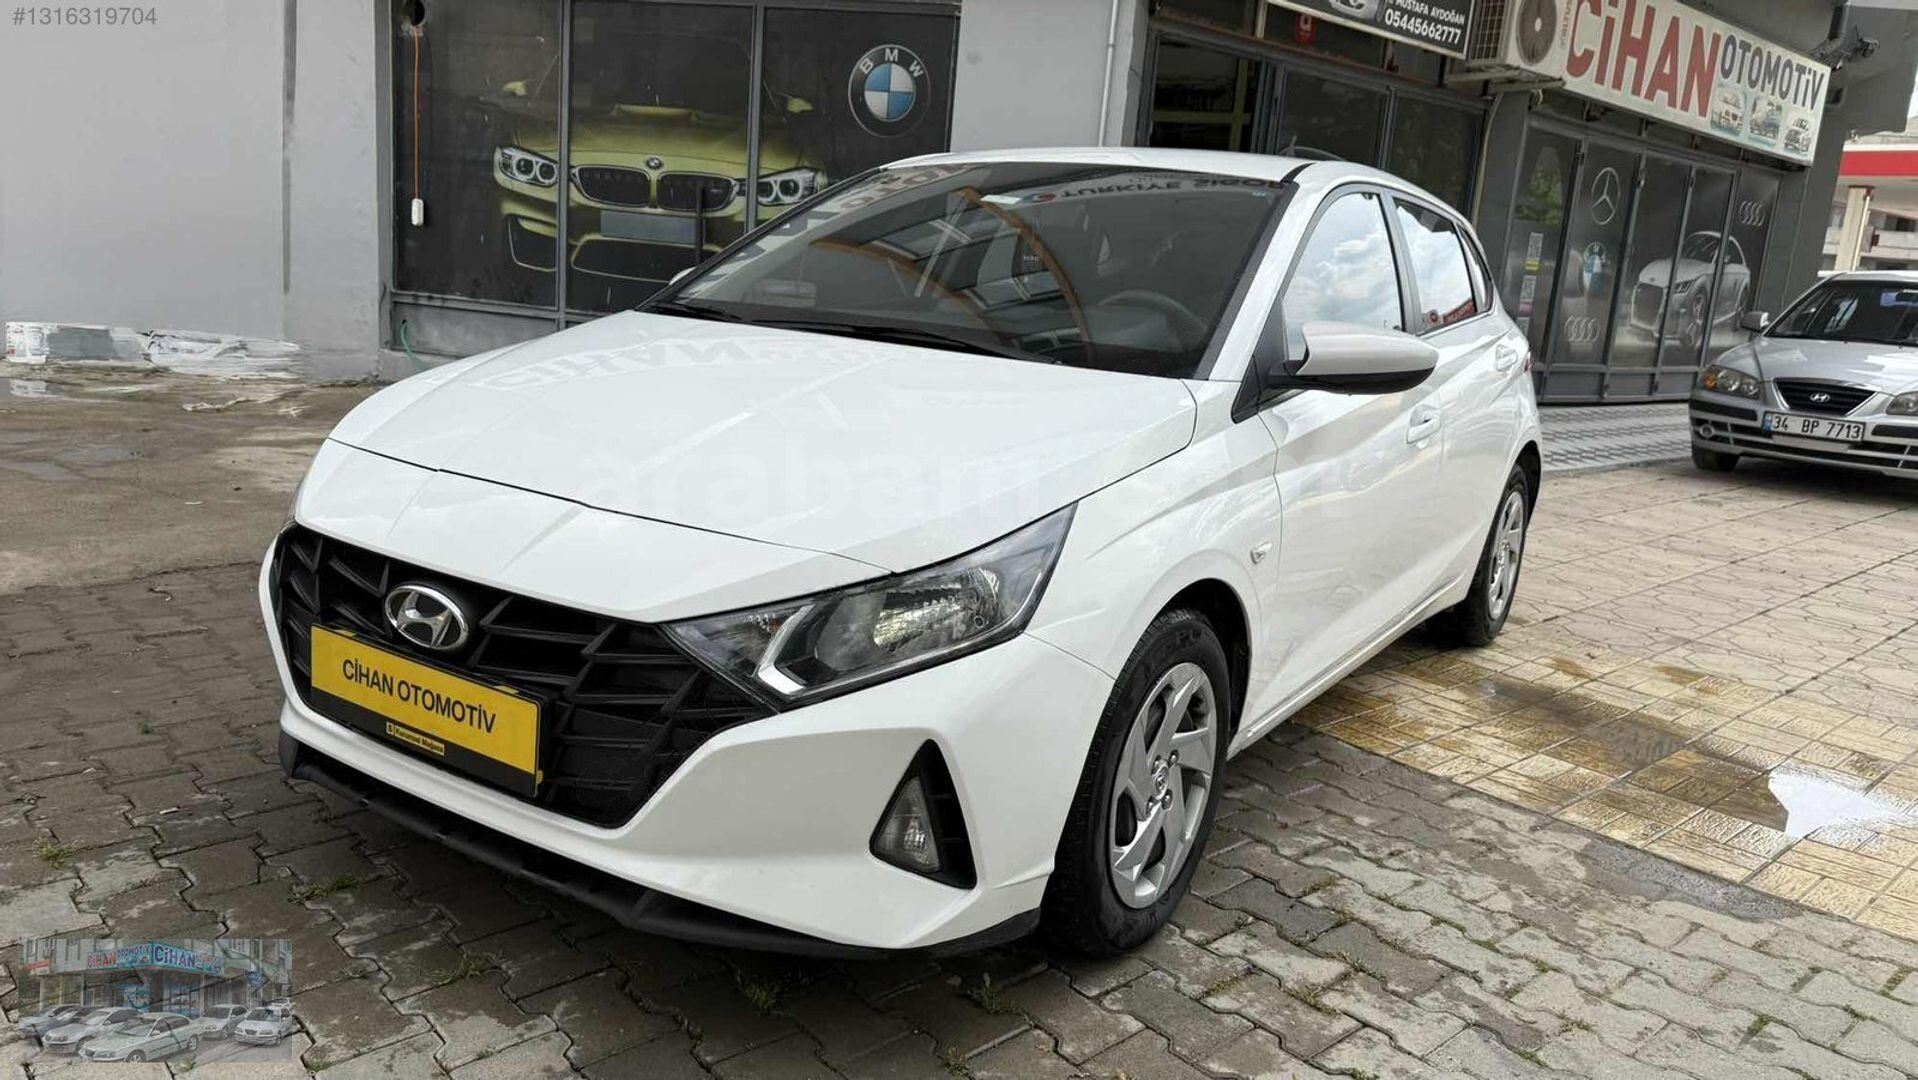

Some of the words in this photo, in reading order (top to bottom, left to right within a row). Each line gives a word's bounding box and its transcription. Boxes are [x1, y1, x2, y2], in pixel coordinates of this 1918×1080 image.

[1385, 9, 1461, 44] 05445662777
[859, 47, 924, 77] BMW
[1774, 416, 1789, 431] 34
[1801, 419, 1820, 434] BP
[1826, 422, 1861, 439] 7713
[342, 657, 394, 698] CİHAN
[397, 679, 497, 734] OTOMOTİV
